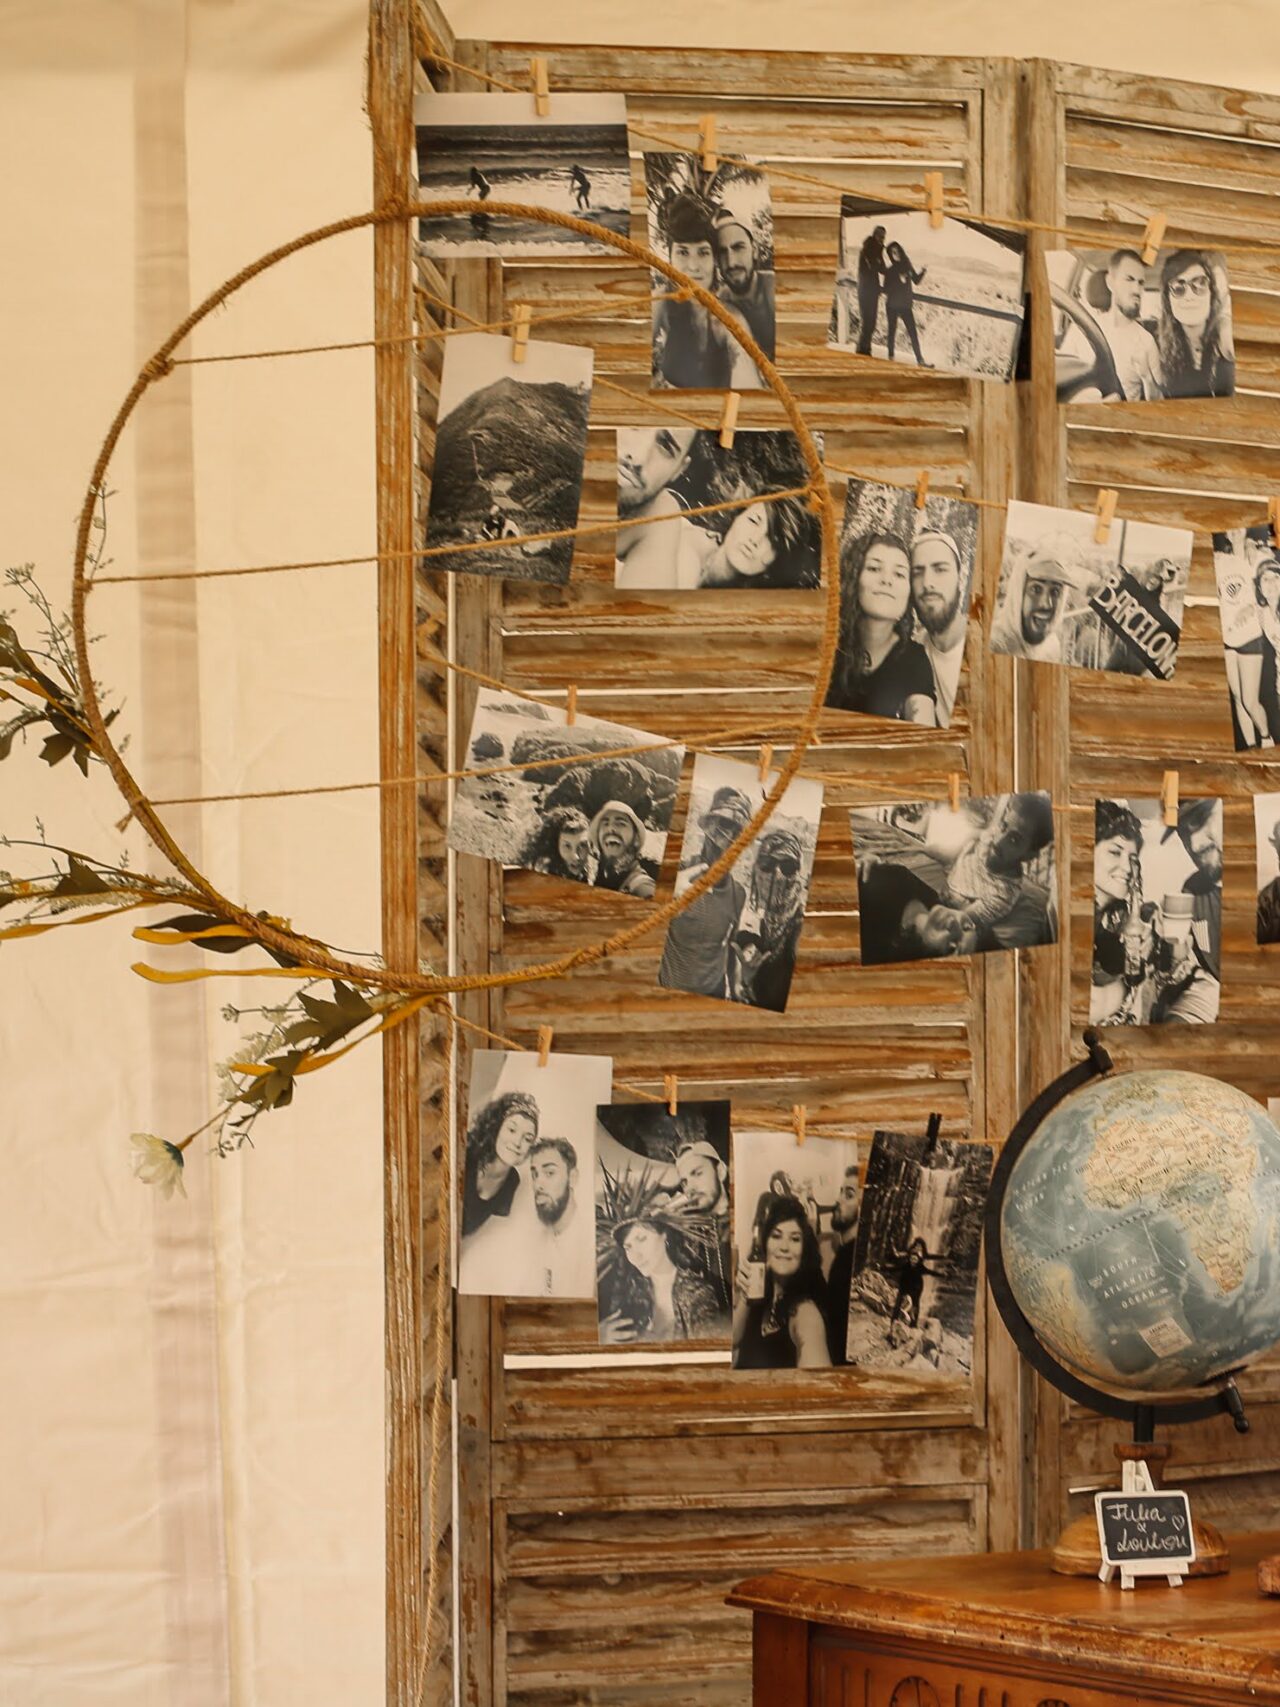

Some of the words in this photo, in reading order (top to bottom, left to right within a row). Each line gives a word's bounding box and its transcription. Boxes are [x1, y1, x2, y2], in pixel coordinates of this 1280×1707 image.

[1103, 1267, 1157, 1300] ATLANTIC
[1121, 1288, 1156, 1310] OCEAN
[1105, 1503, 1167, 1523] Julia
